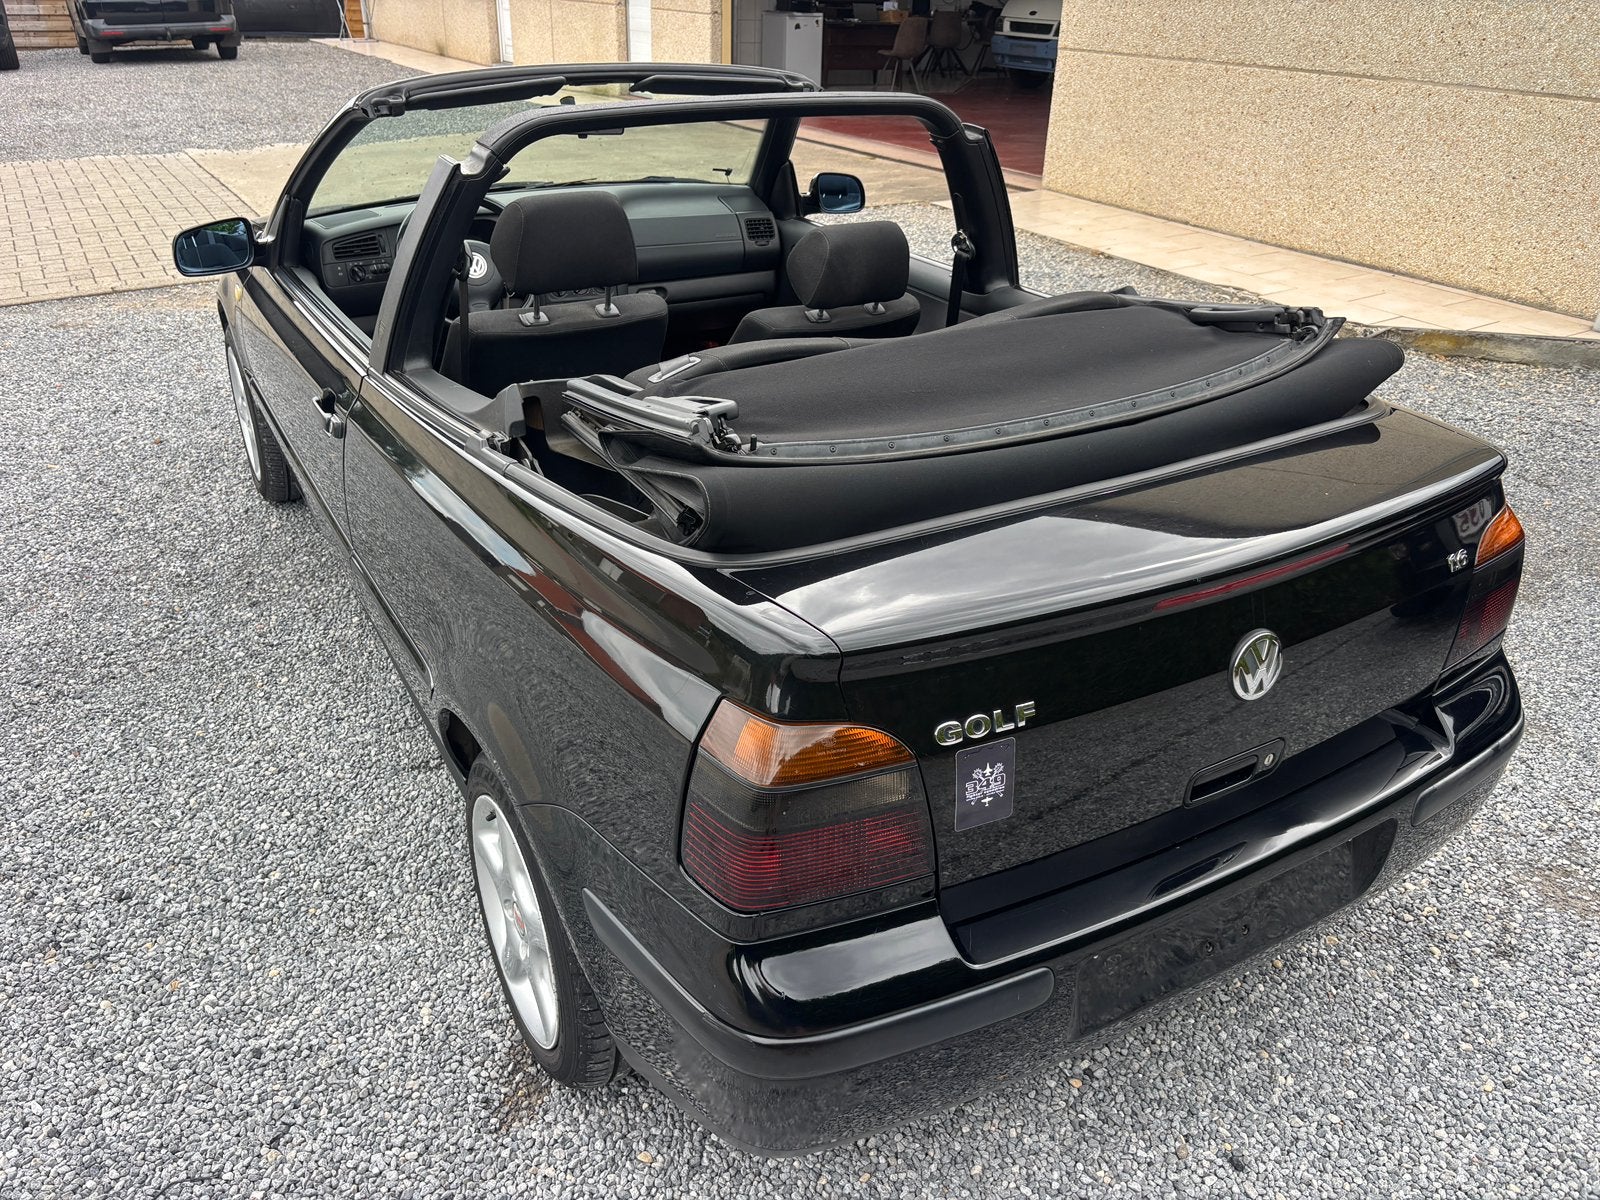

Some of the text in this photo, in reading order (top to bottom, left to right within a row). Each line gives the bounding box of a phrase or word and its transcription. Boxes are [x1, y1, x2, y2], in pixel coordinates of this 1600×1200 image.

[1232, 630, 1282, 700] VW
[934, 701, 1036, 746] GOLF
[966, 773, 1006, 796] 349
